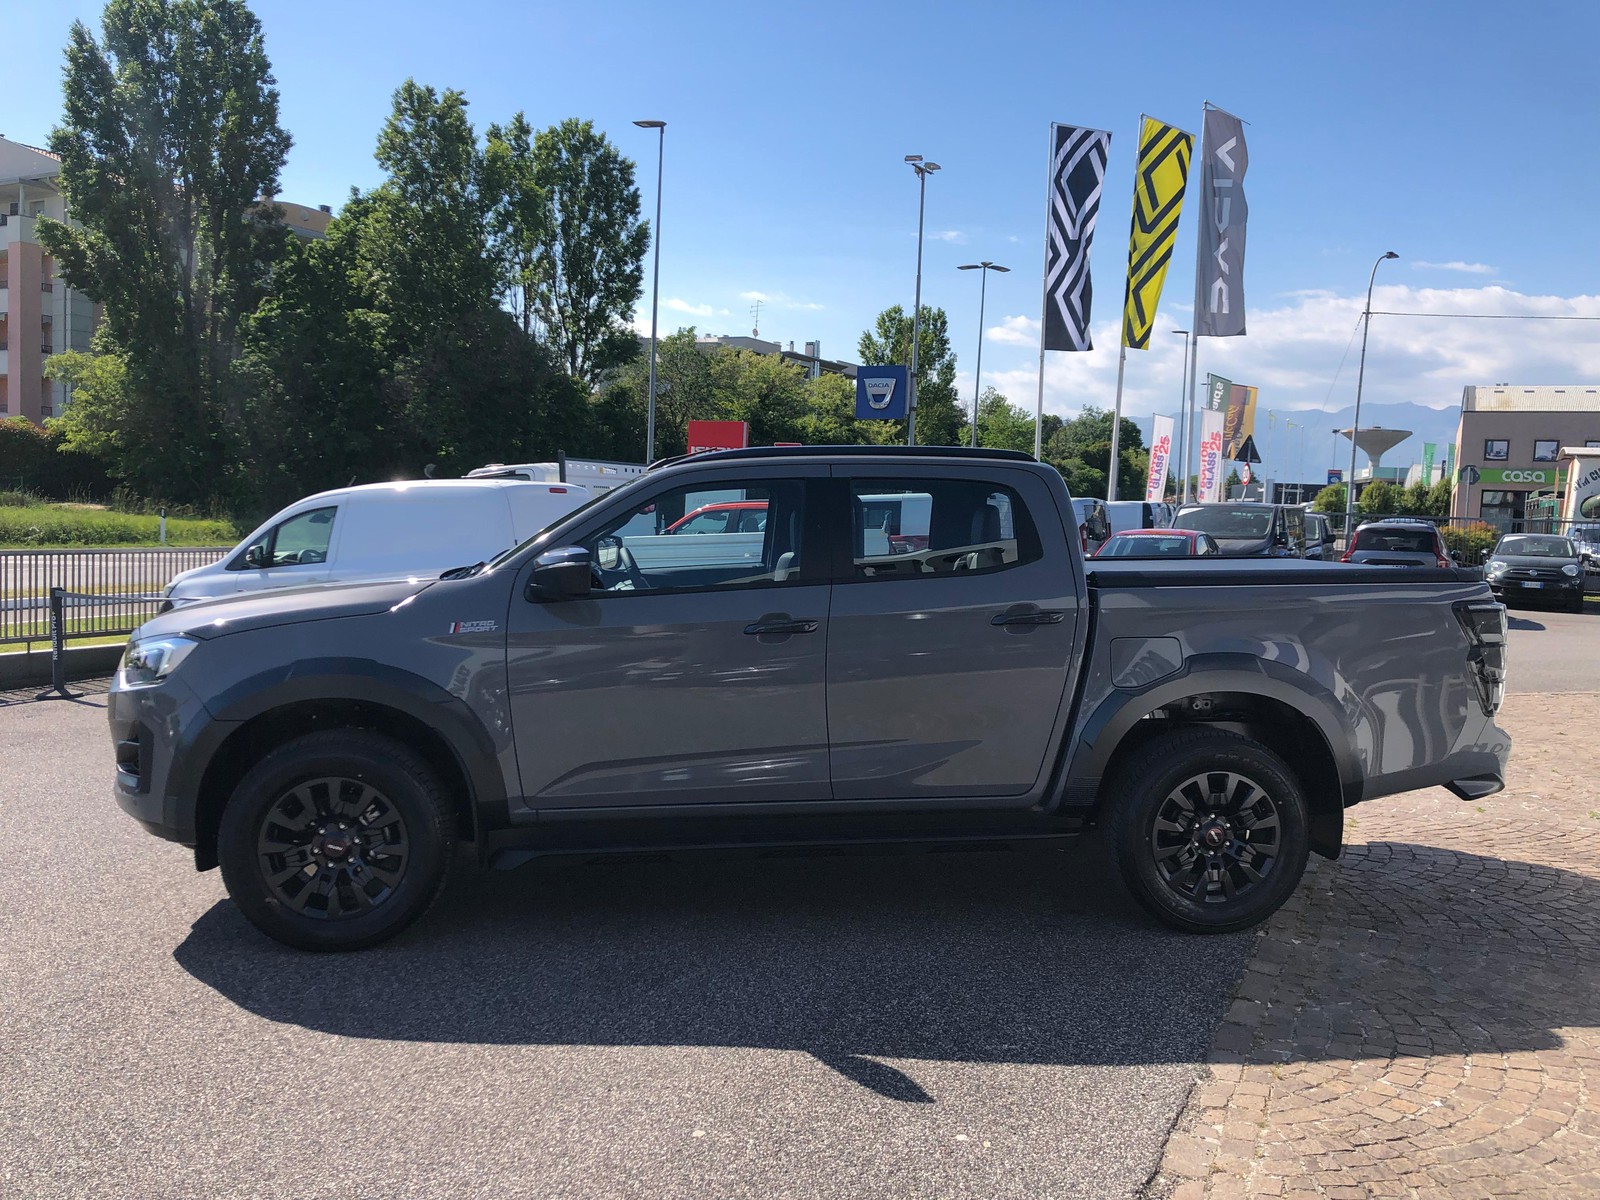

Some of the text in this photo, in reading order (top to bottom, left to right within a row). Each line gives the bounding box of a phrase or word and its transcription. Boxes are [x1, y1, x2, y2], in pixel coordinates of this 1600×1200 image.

[1210, 432, 1221, 452] 25
[1153, 455, 1164, 489] GLASS
[1206, 452, 1217, 489] GLASS
